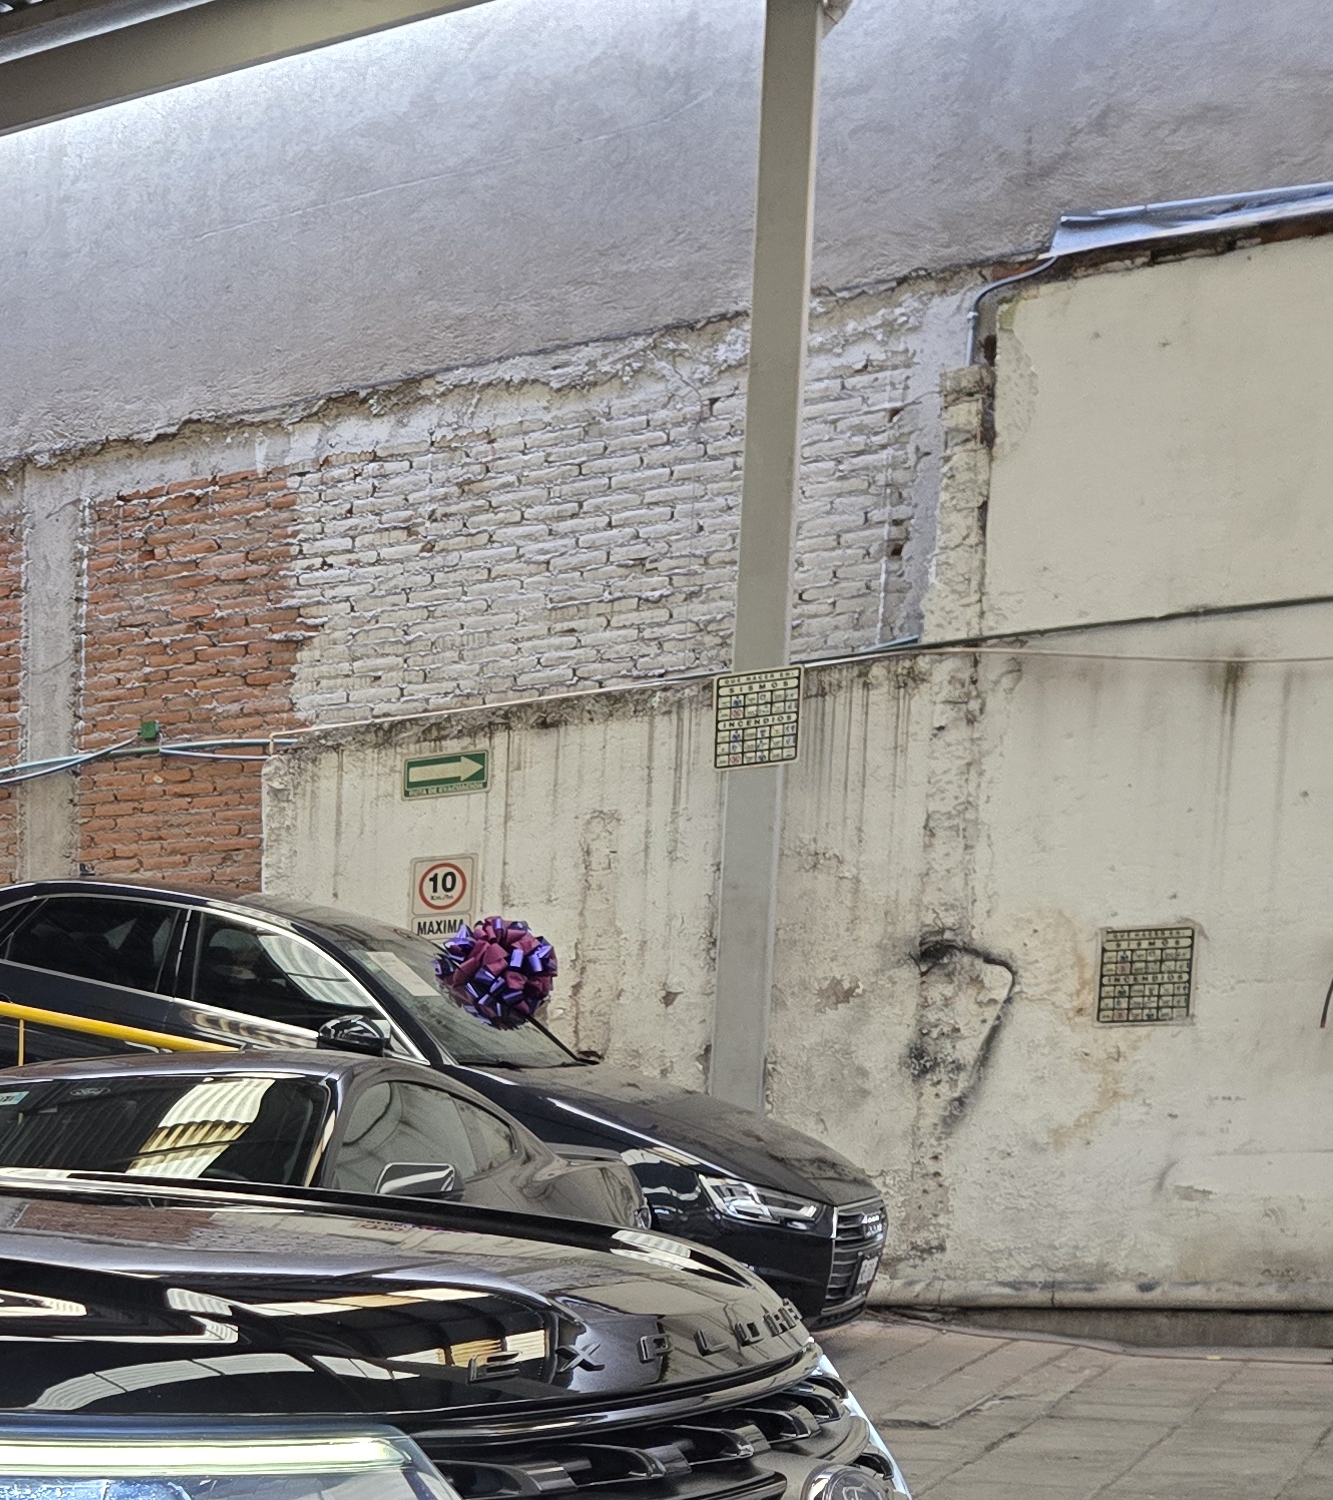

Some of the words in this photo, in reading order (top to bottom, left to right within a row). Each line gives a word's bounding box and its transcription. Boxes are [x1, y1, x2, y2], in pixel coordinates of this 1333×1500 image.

[729, 681, 789, 693] SISMOS
[722, 715, 792, 729] INCENDIOS
[428, 871, 457, 893] 10
[466, 1297, 803, 1384] EXPLORE
